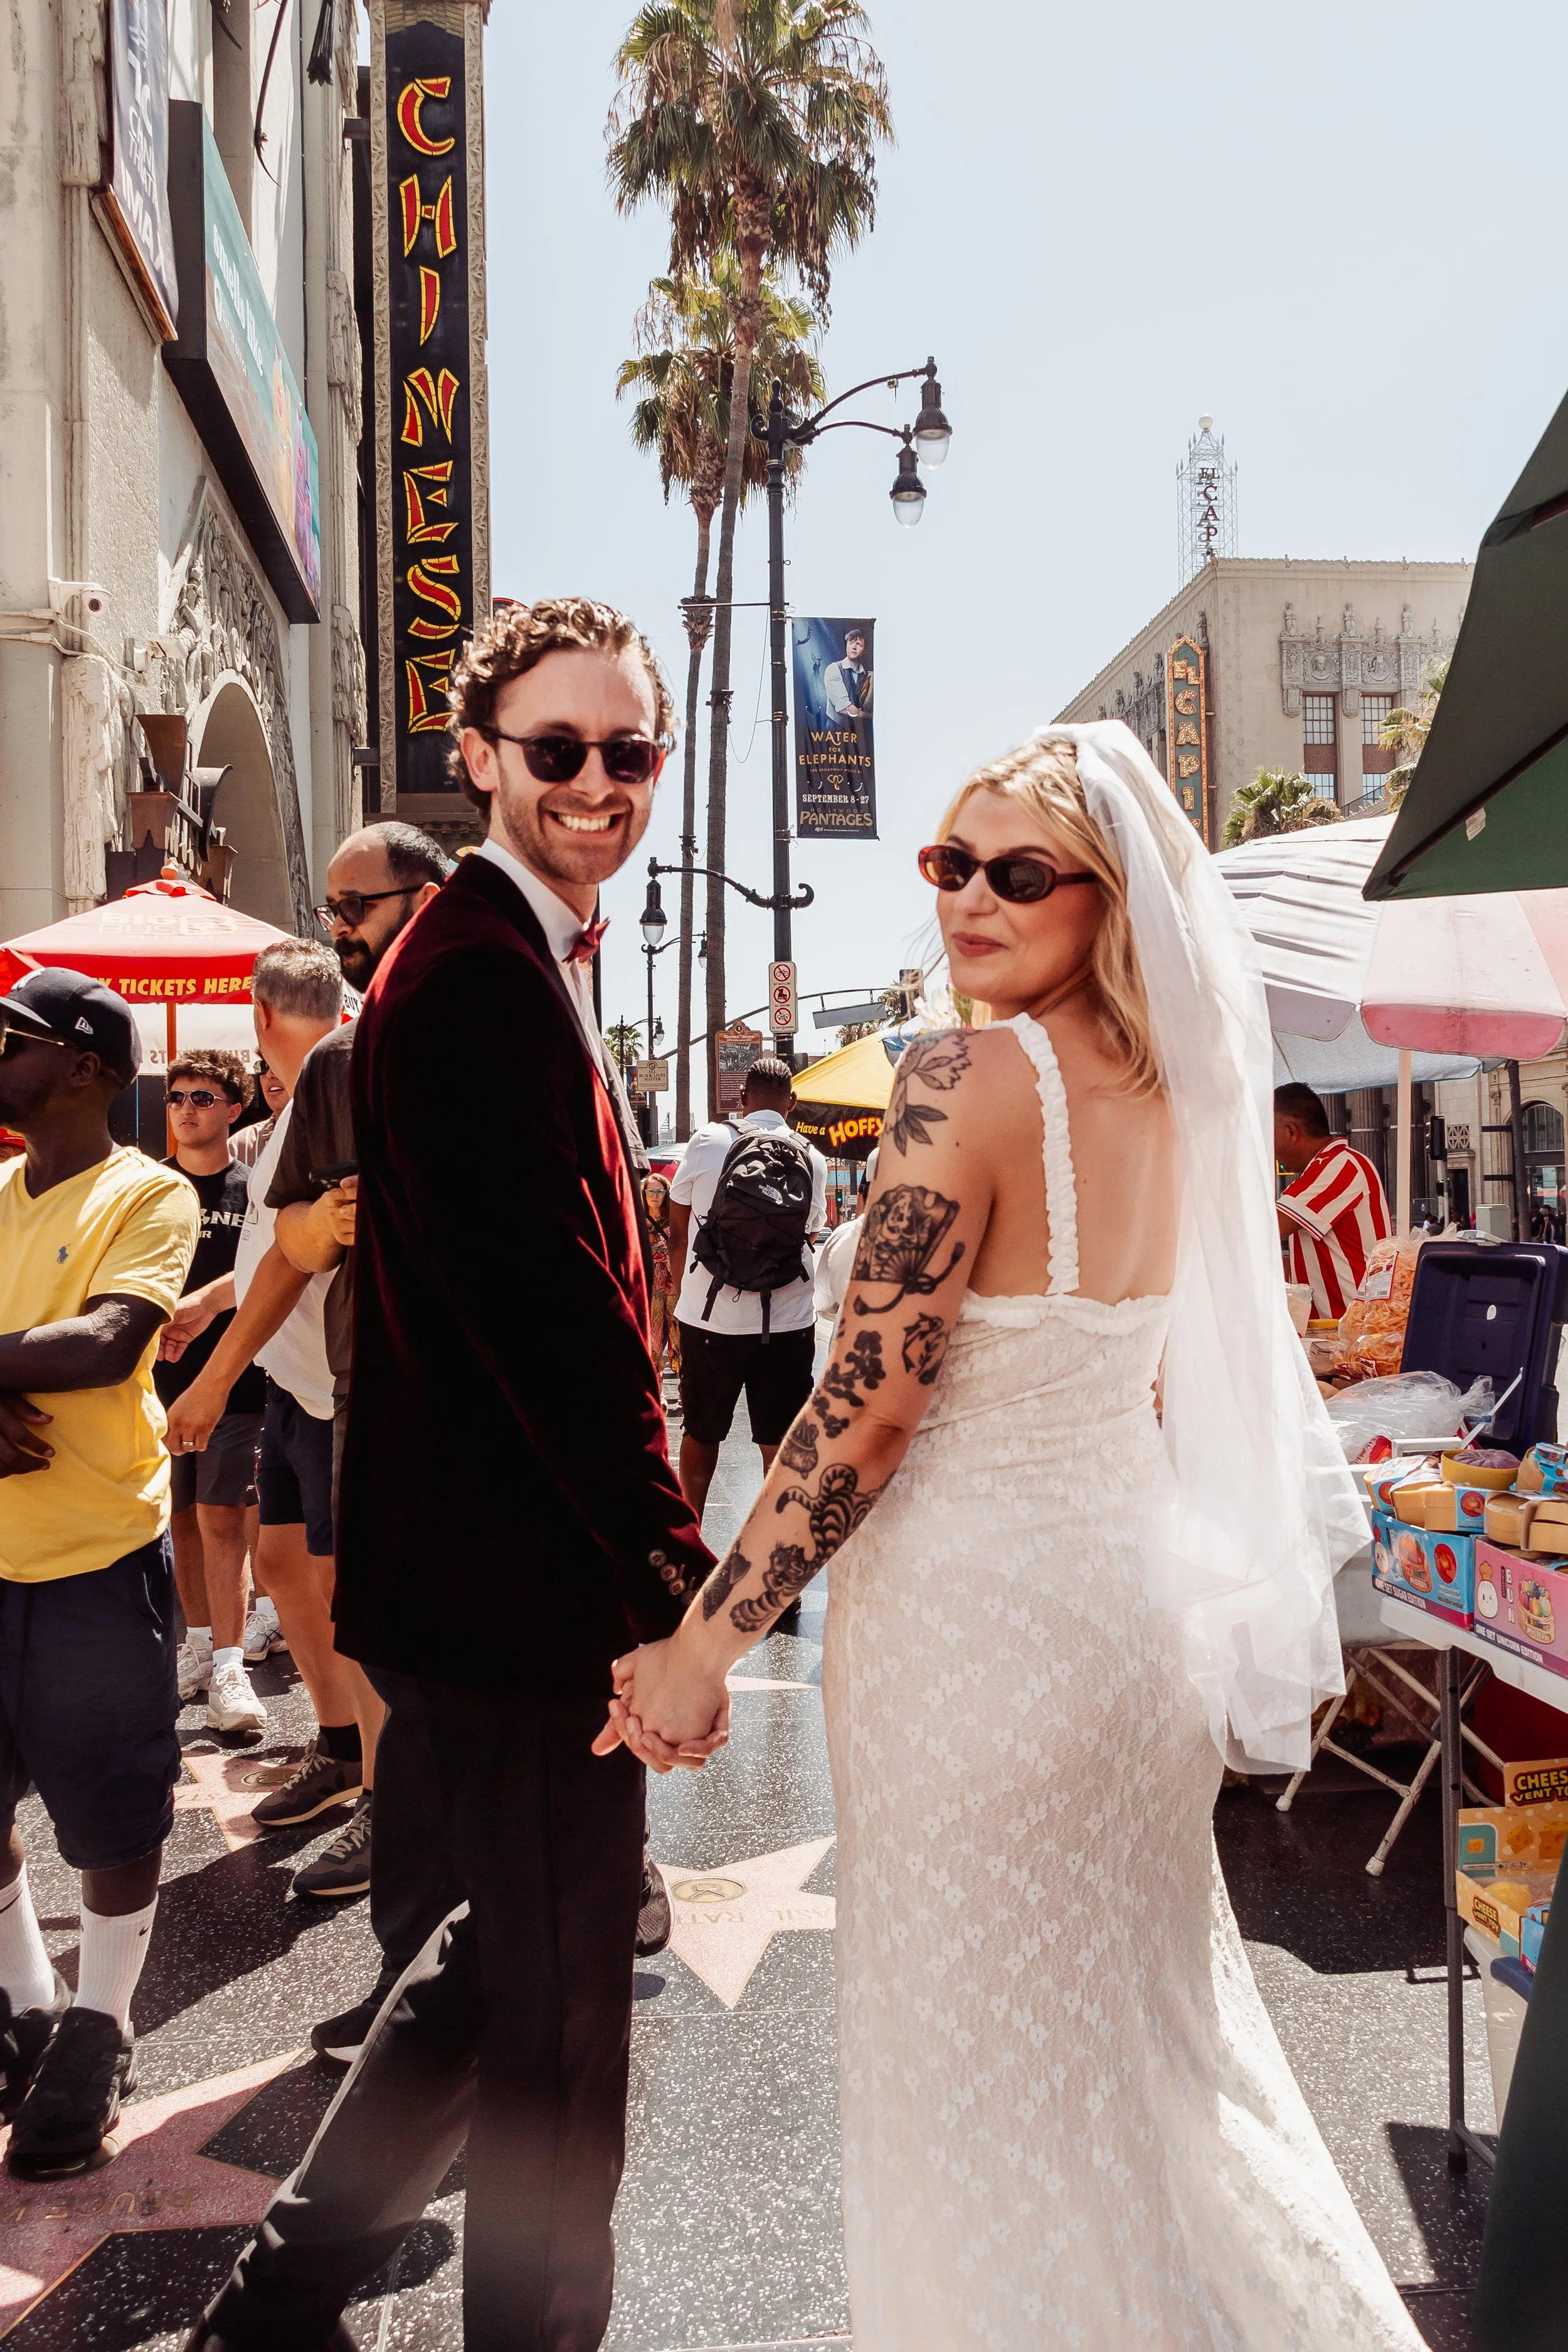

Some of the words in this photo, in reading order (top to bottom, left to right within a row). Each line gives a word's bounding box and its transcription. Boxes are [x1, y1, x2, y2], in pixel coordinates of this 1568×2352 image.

[121, 157, 167, 286] IMAX
[396, 75, 461, 734] CHINESE
[1200, 467, 1220, 479] EL
[1202, 485, 1221, 558] CAPI
[1173, 660, 1200, 685] EL
[811, 731, 857, 746] WATER
[798, 754, 871, 767] ELEPHANTS
[802, 794, 849, 803] SEPTEMBER
[800, 811, 874, 827] PANTAGES
[101, 913, 180, 925] BIG
[98, 923, 176, 935] BUS
[119, 978, 196, 996] TICKETS
[204, 977, 252, 995] HERE
[795, 1121, 818, 1135] Have
[819, 1126, 826, 1135] a
[829, 1116, 883, 1147] HOFFY
[1407, 1592, 1427, 1609] EDITION
[1475, 1623, 1486, 1636] ONE
[1486, 1628, 1495, 1641] SET
[1496, 1633, 1520, 1653] UNICORN
[1520, 1645, 1544, 1664] EDITION
[1517, 1770, 1568, 1790] CHEES
[1513, 1788, 1552, 1801] VENT
[1474, 1899, 1498, 1922] CHEESE
[1475, 1911, 1488, 1922] VENT
[1488, 1918, 1499, 1931] TOY
